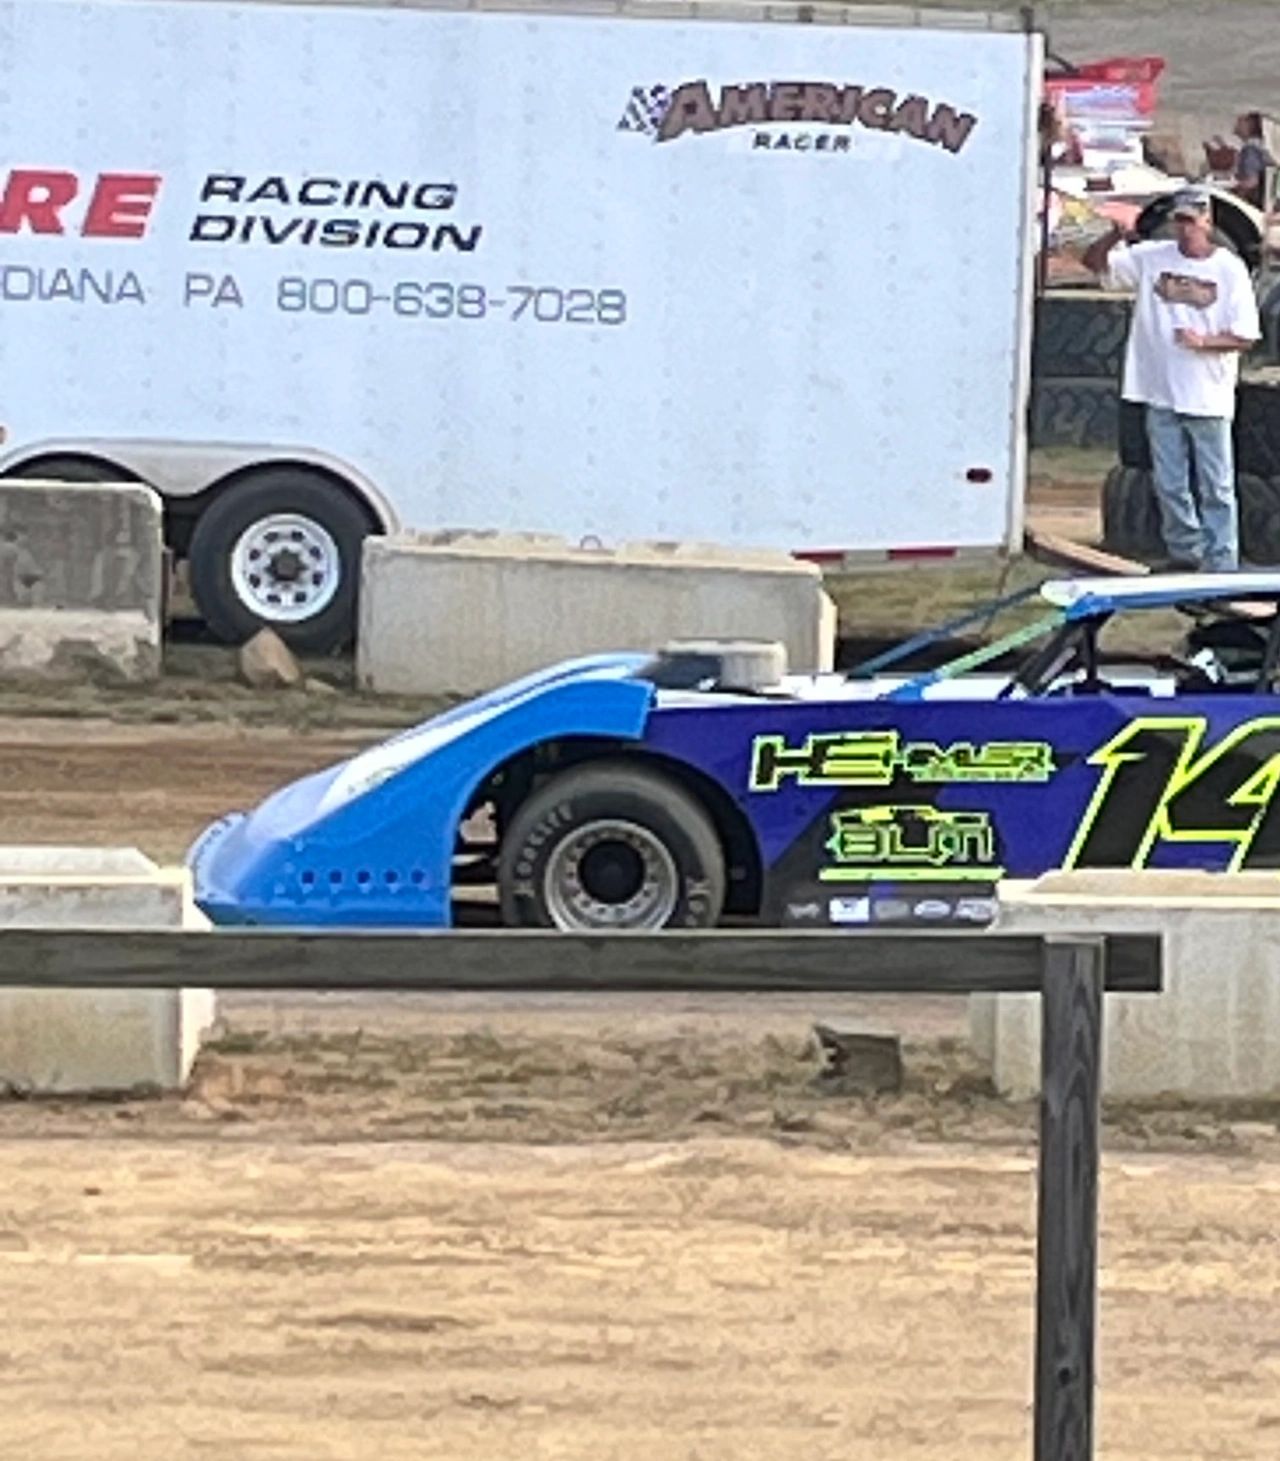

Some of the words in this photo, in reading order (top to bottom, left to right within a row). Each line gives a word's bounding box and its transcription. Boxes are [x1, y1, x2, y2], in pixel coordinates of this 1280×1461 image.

[655, 79, 978, 154] AMERICAN
[752, 133, 852, 152] RACER
[0, 169, 162, 238] RE
[200, 173, 458, 211] RACING
[188, 213, 482, 252] DIVISION
[183, 271, 244, 308] PA
[276, 276, 627, 326] 800-638-7028
